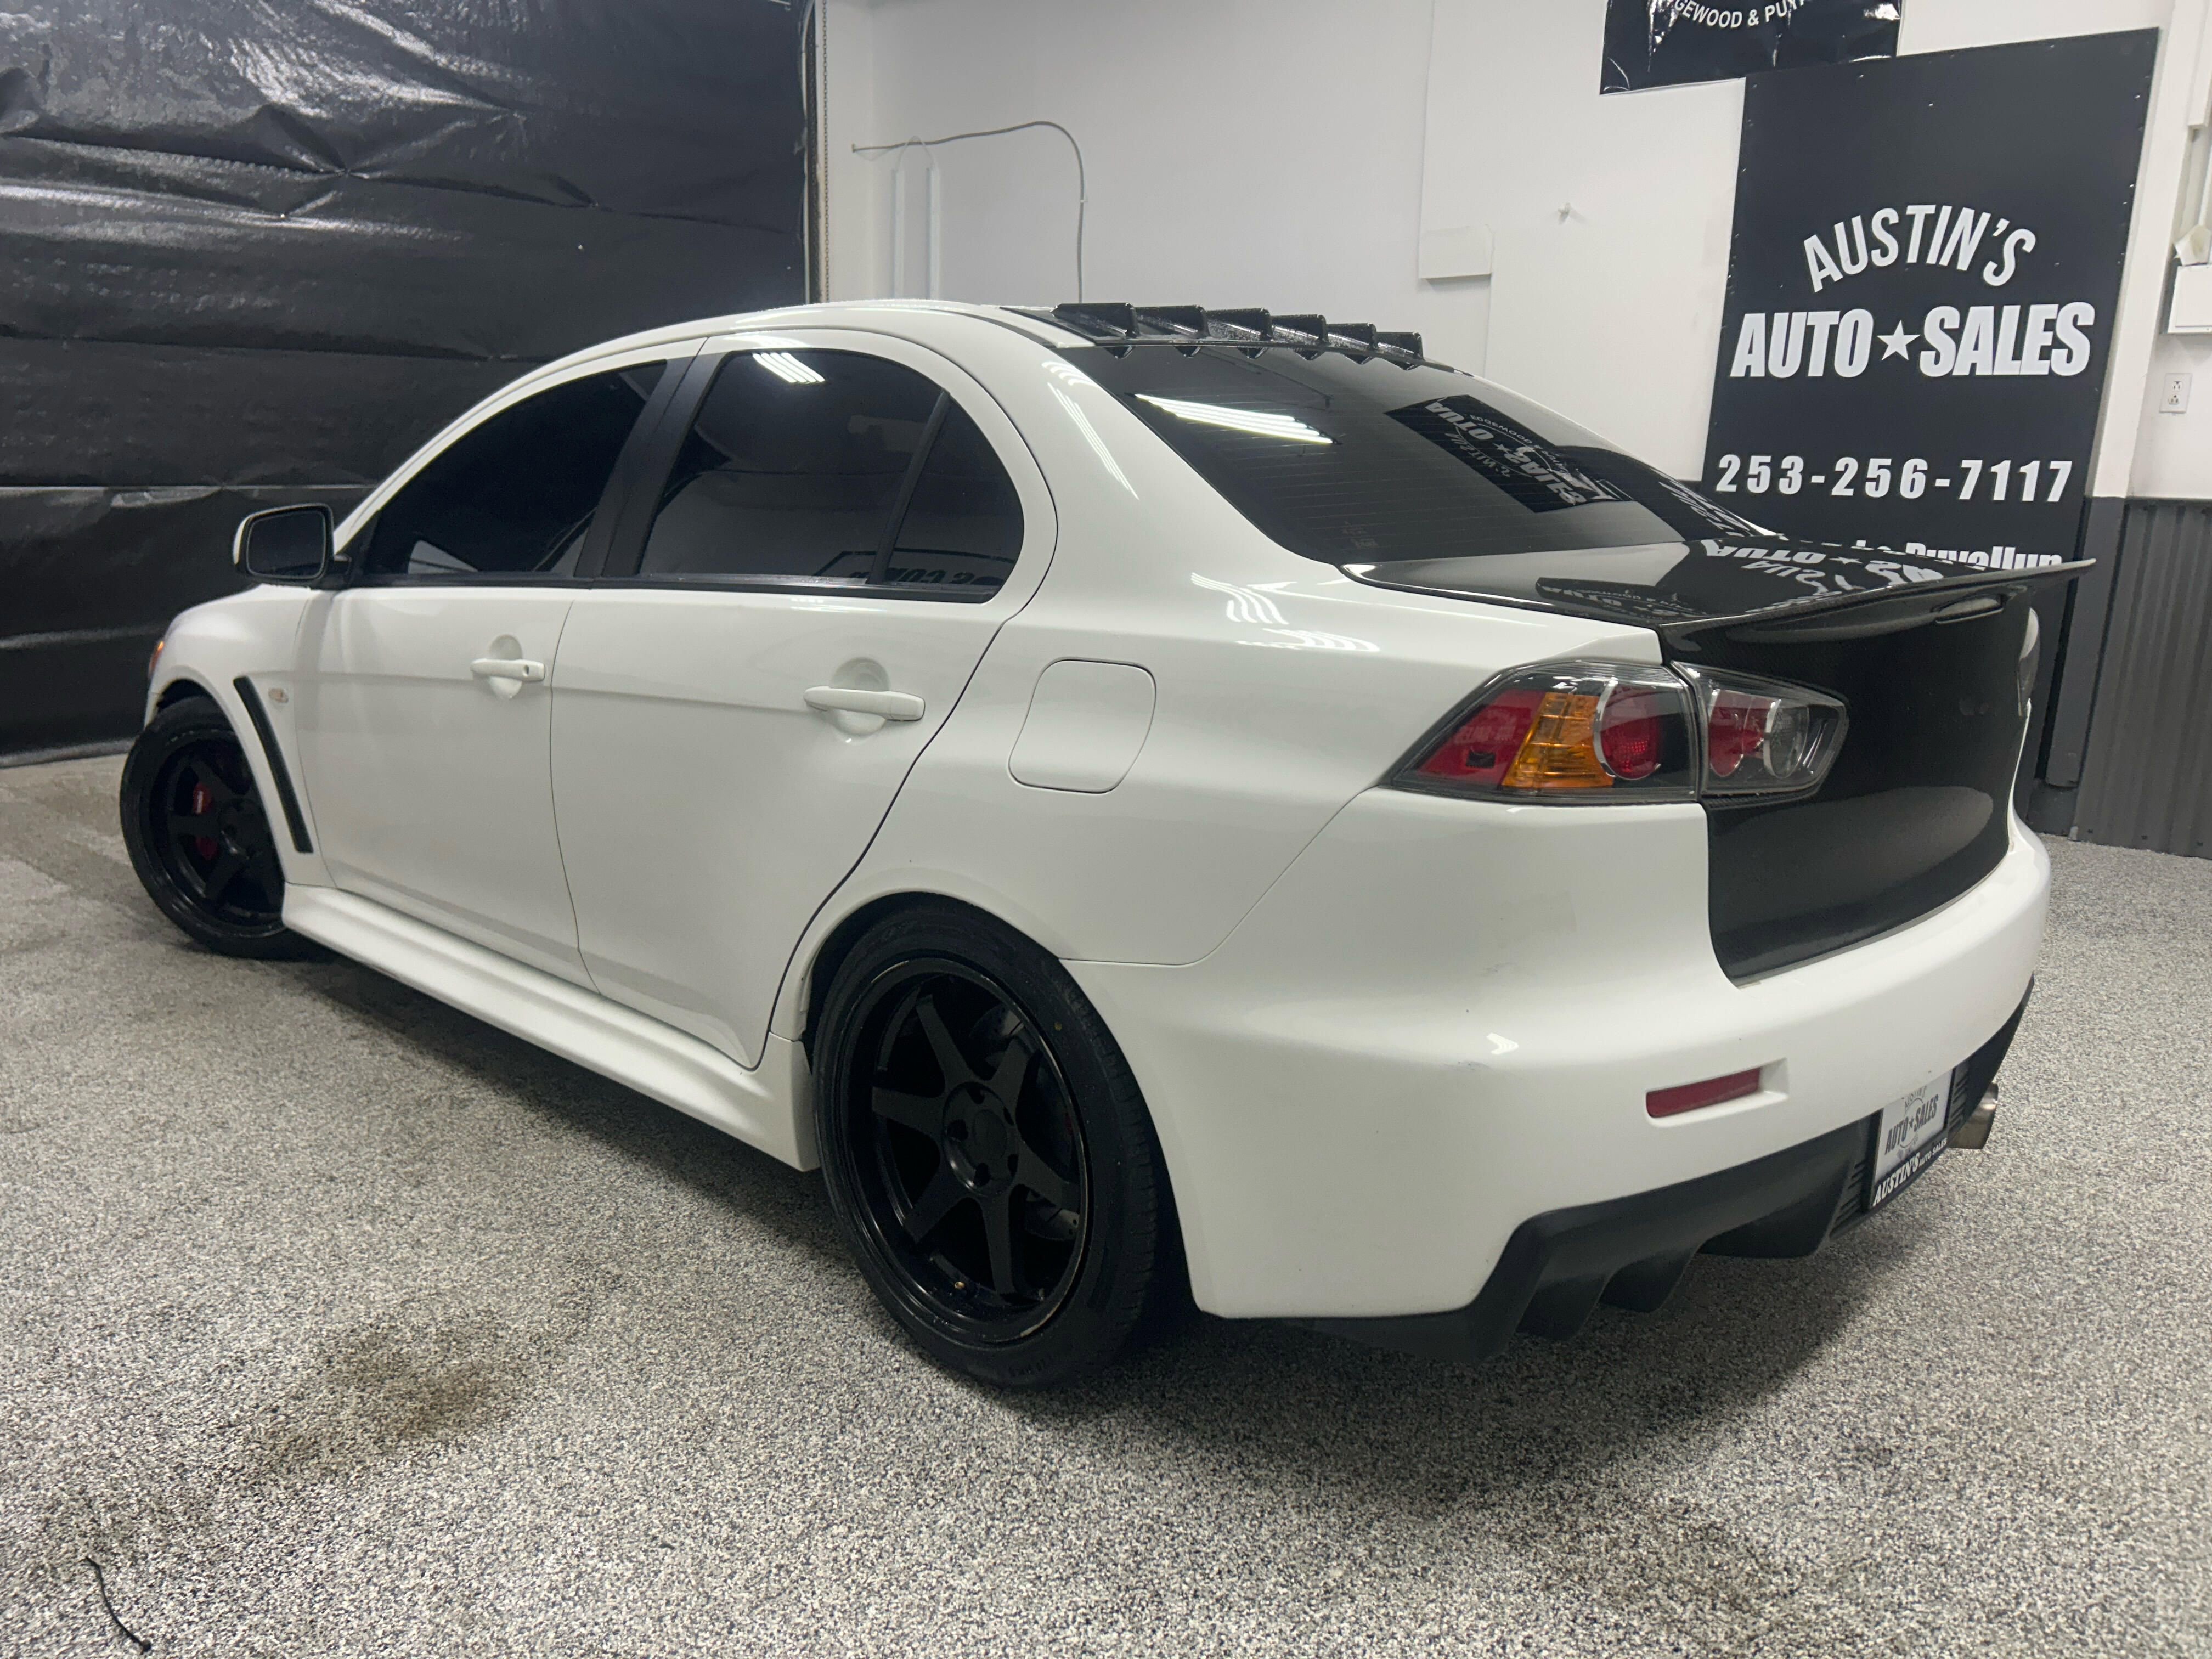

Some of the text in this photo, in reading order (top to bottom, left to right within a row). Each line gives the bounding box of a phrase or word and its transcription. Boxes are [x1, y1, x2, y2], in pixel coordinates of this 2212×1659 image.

[1674, 0, 1743, 29] GEWOOD
[1747, 9, 1759, 27] &
[1803, 204, 2036, 293] AUSTIN'S
[1730, 302, 2096, 379] AUTO SALES
[1716, 454, 2074, 503] 253-256-7117
[1884, 1116, 1909, 1156] AUTO
[1913, 1093, 1939, 1133] SALES
[1872, 1151, 1921, 1207] AUSTIN'S
[1919, 1150, 1932, 1167] AUTO
[1931, 1137, 1948, 1156] SALES
